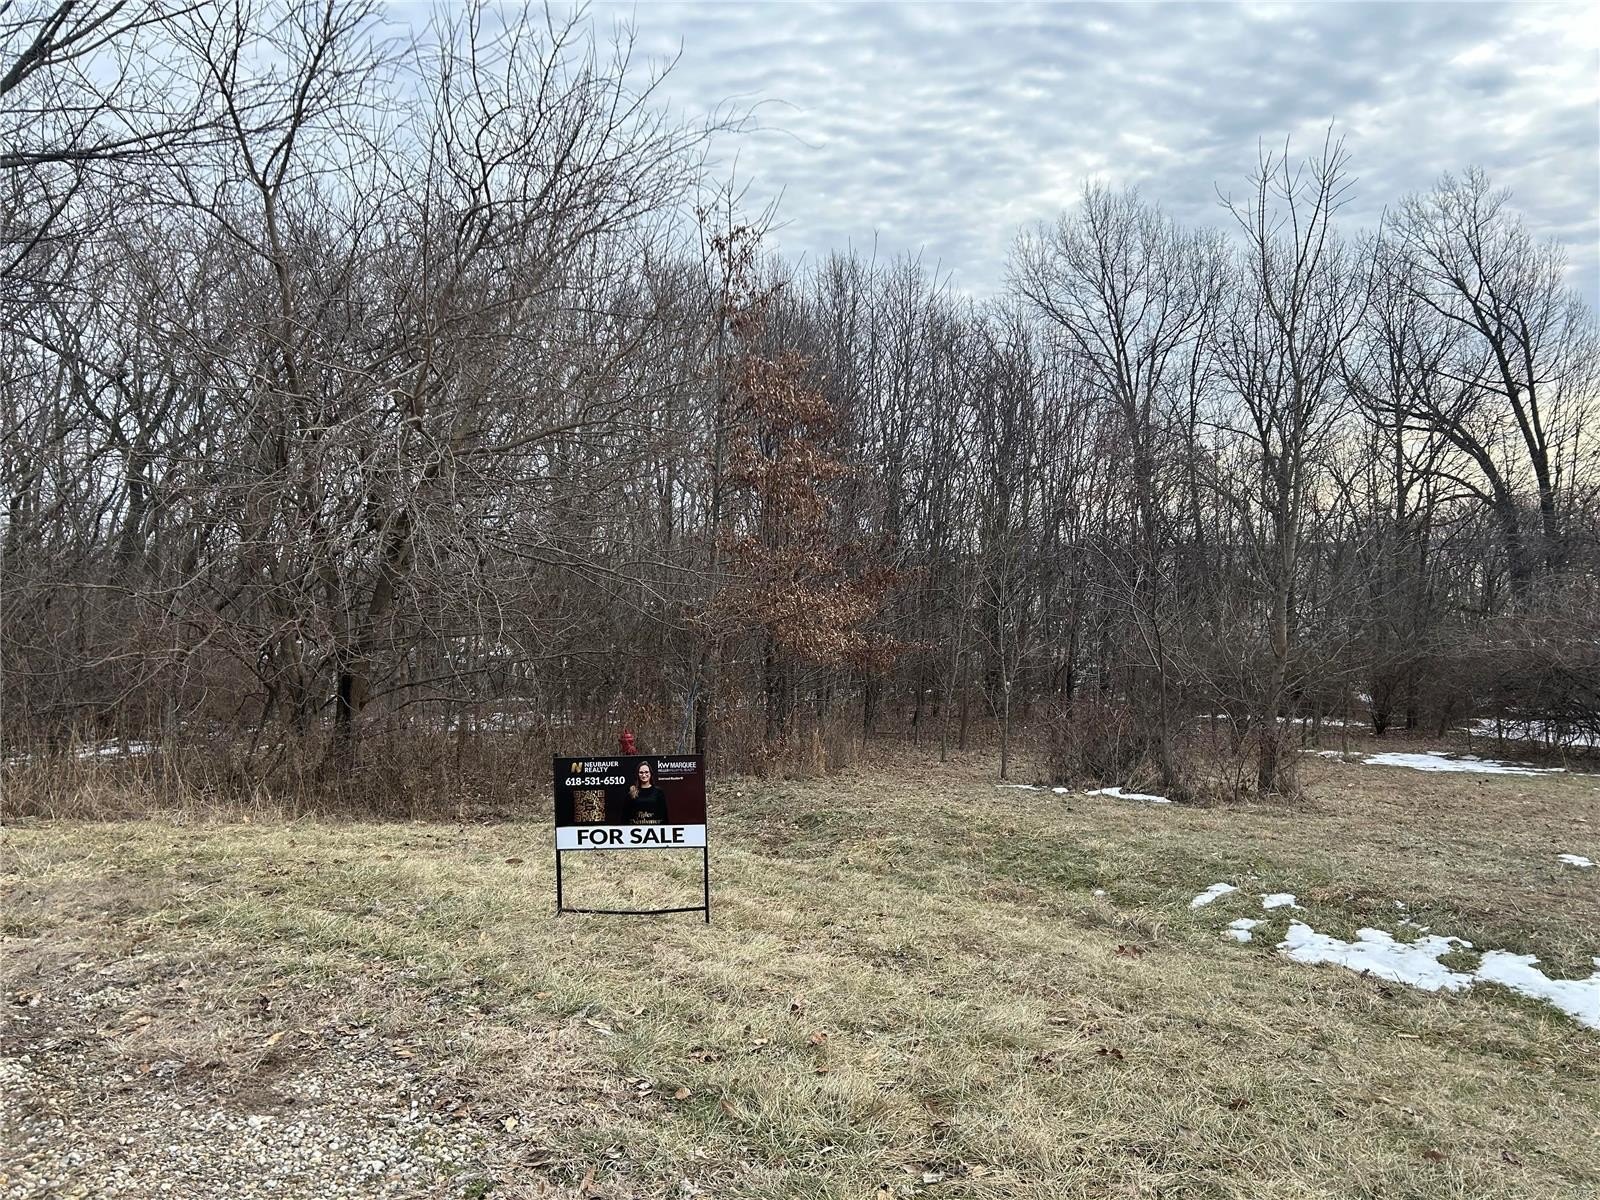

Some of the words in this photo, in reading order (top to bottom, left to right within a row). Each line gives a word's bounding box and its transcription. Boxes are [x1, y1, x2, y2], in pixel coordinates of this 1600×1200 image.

[670, 761, 697, 769] MARQUEE
[565, 776, 626, 786] 618-531-6510
[577, 828, 625, 846] FOR
[629, 827, 685, 844] SALE
